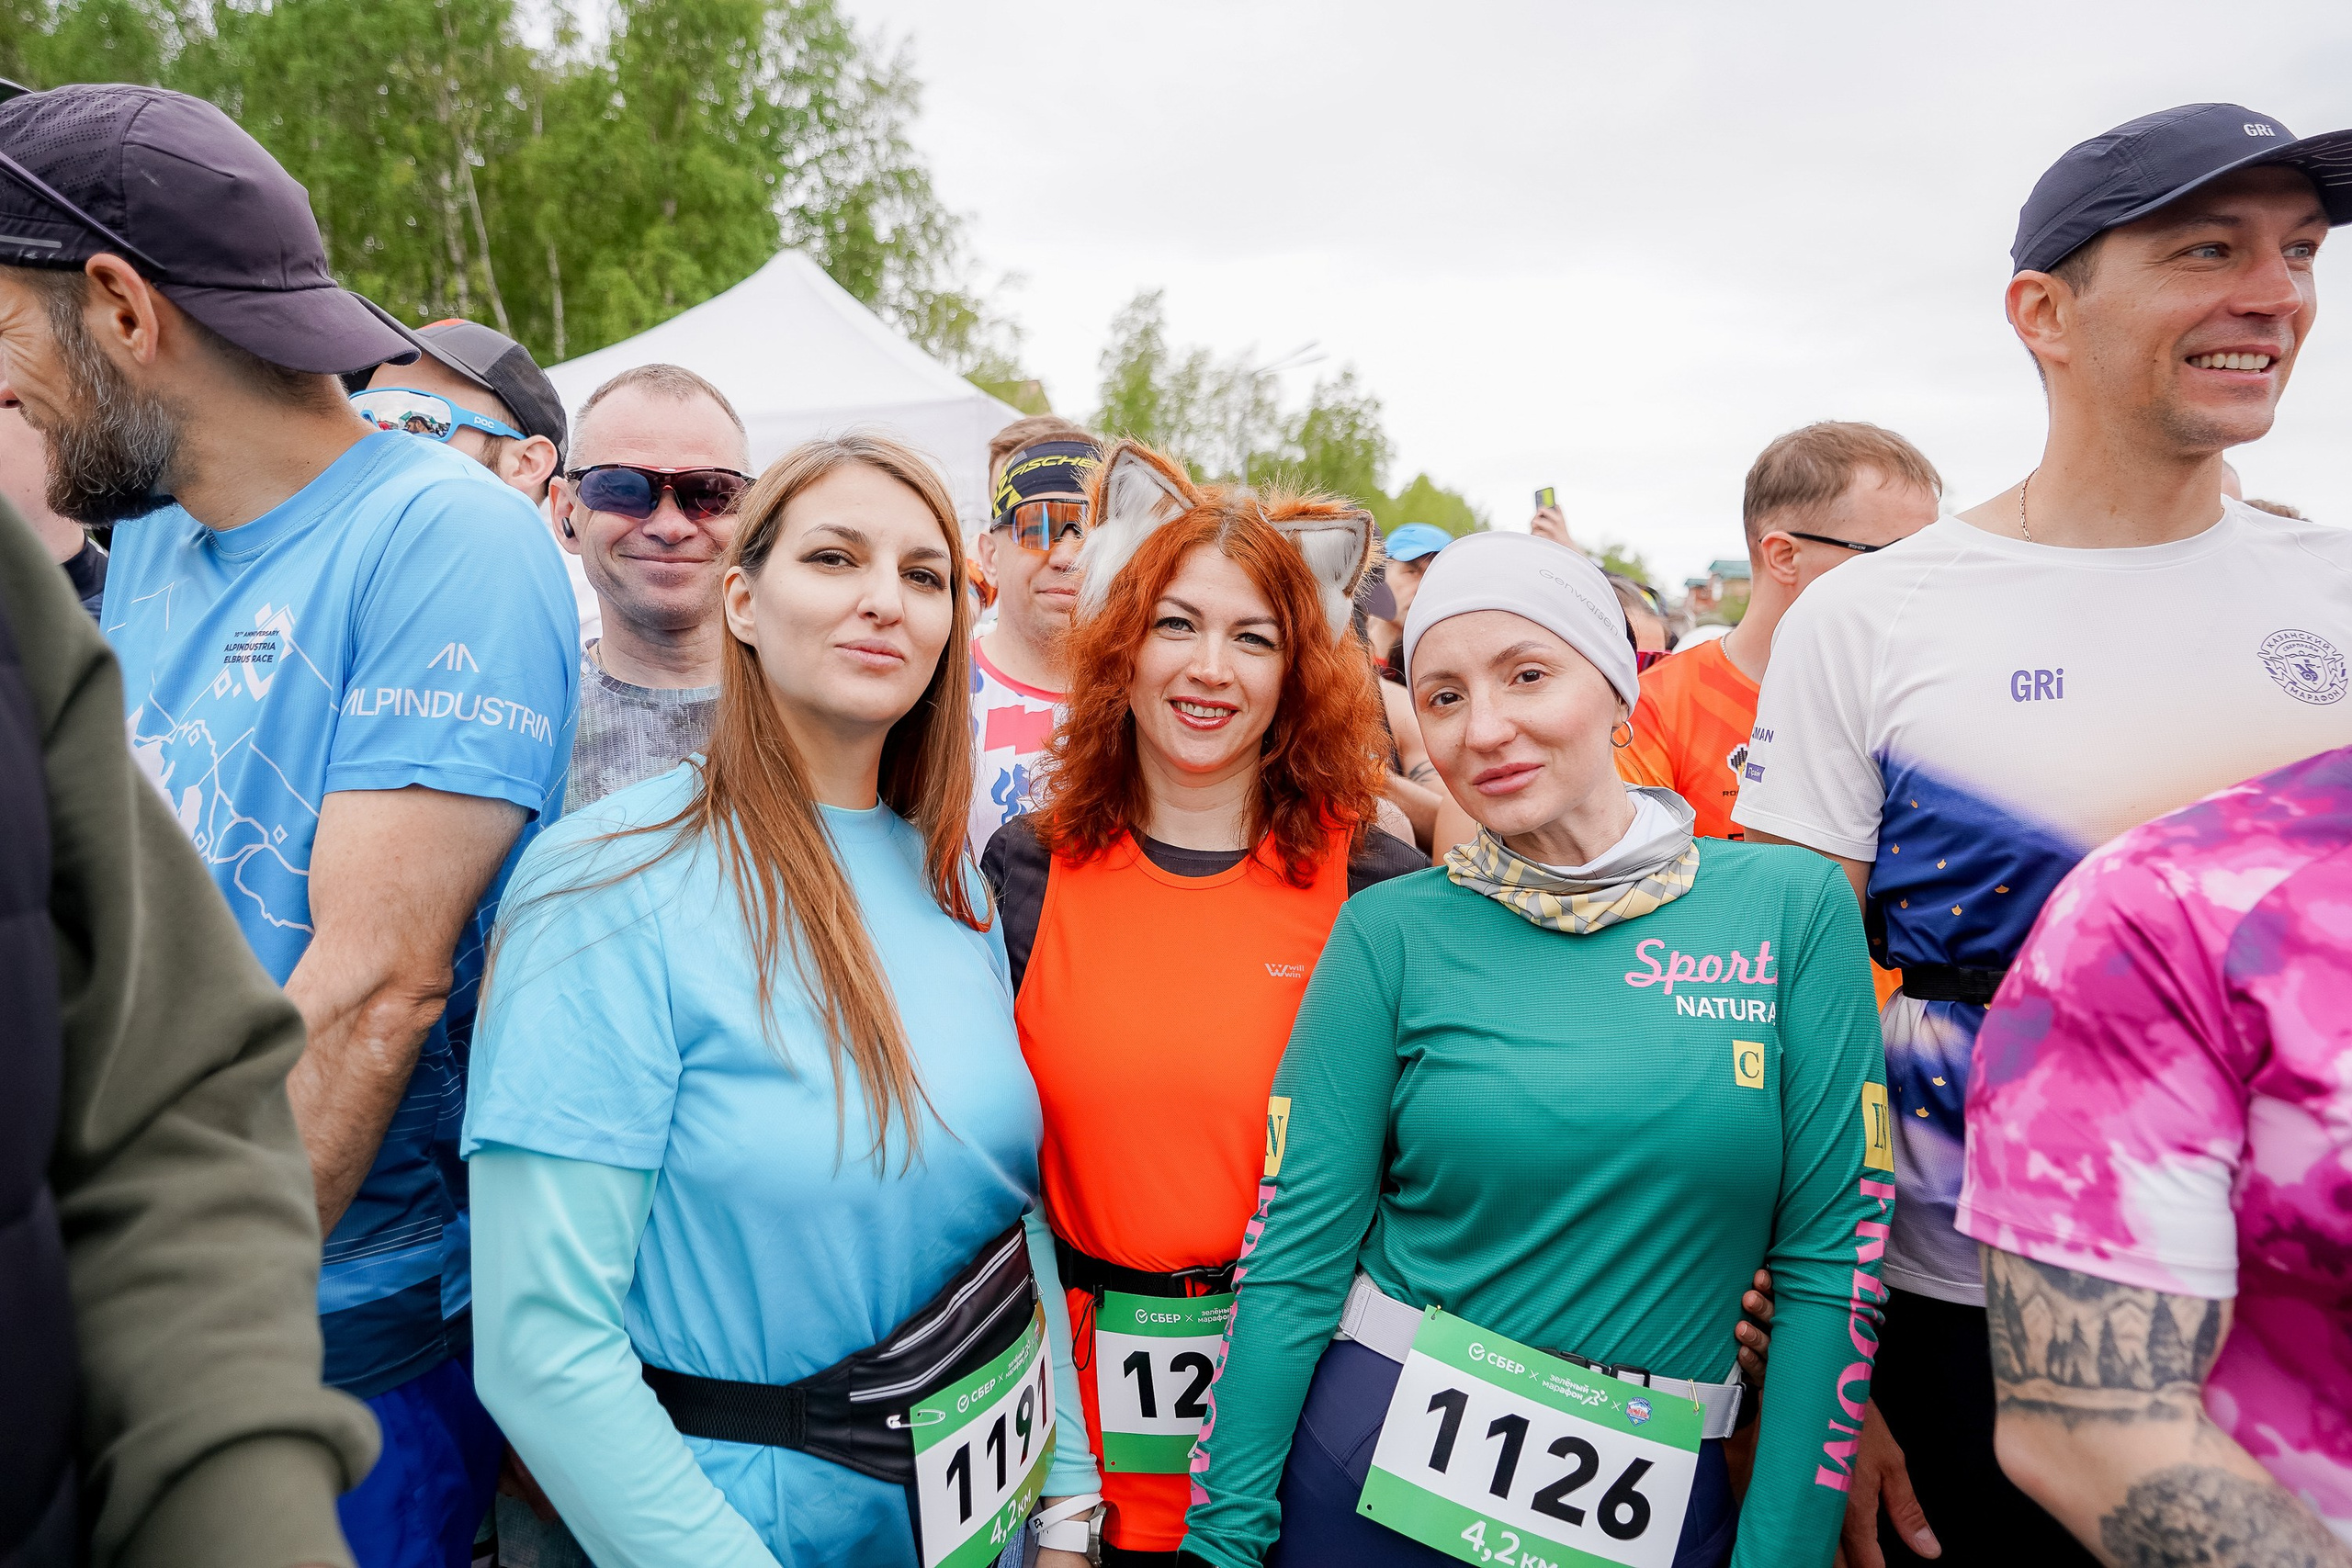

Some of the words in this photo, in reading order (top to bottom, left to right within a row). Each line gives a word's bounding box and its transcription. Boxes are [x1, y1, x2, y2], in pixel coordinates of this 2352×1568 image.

[2243, 124, 2276, 137] GRi
[1009, 454, 1102, 484] FISCHE
[1539, 569, 1619, 637] Genwarsen
[223, 642, 276, 652] ALPINDUSTRIA
[2266, 632, 2331, 650] КАЗАНСКИЙ
[223, 655, 251, 664] ELBRUS
[251, 654, 274, 663] RACE
[2010, 668, 2064, 703] GRi
[2290, 686, 2341, 703] МАРАФОН
[1624, 938, 1778, 996] Sport
[1739, 1050, 1760, 1079] C
[1150, 1313, 1182, 1324] СБЕР
[1487, 1351, 1526, 1375] СБЕР
[1549, 1372, 1589, 1395] зелёный
[971, 1378, 996, 1404] СБЕР
[1542, 1380, 1584, 1401] марафон
[946, 1354, 1047, 1526] 1191
[1426, 1387, 1657, 1542] 1126
